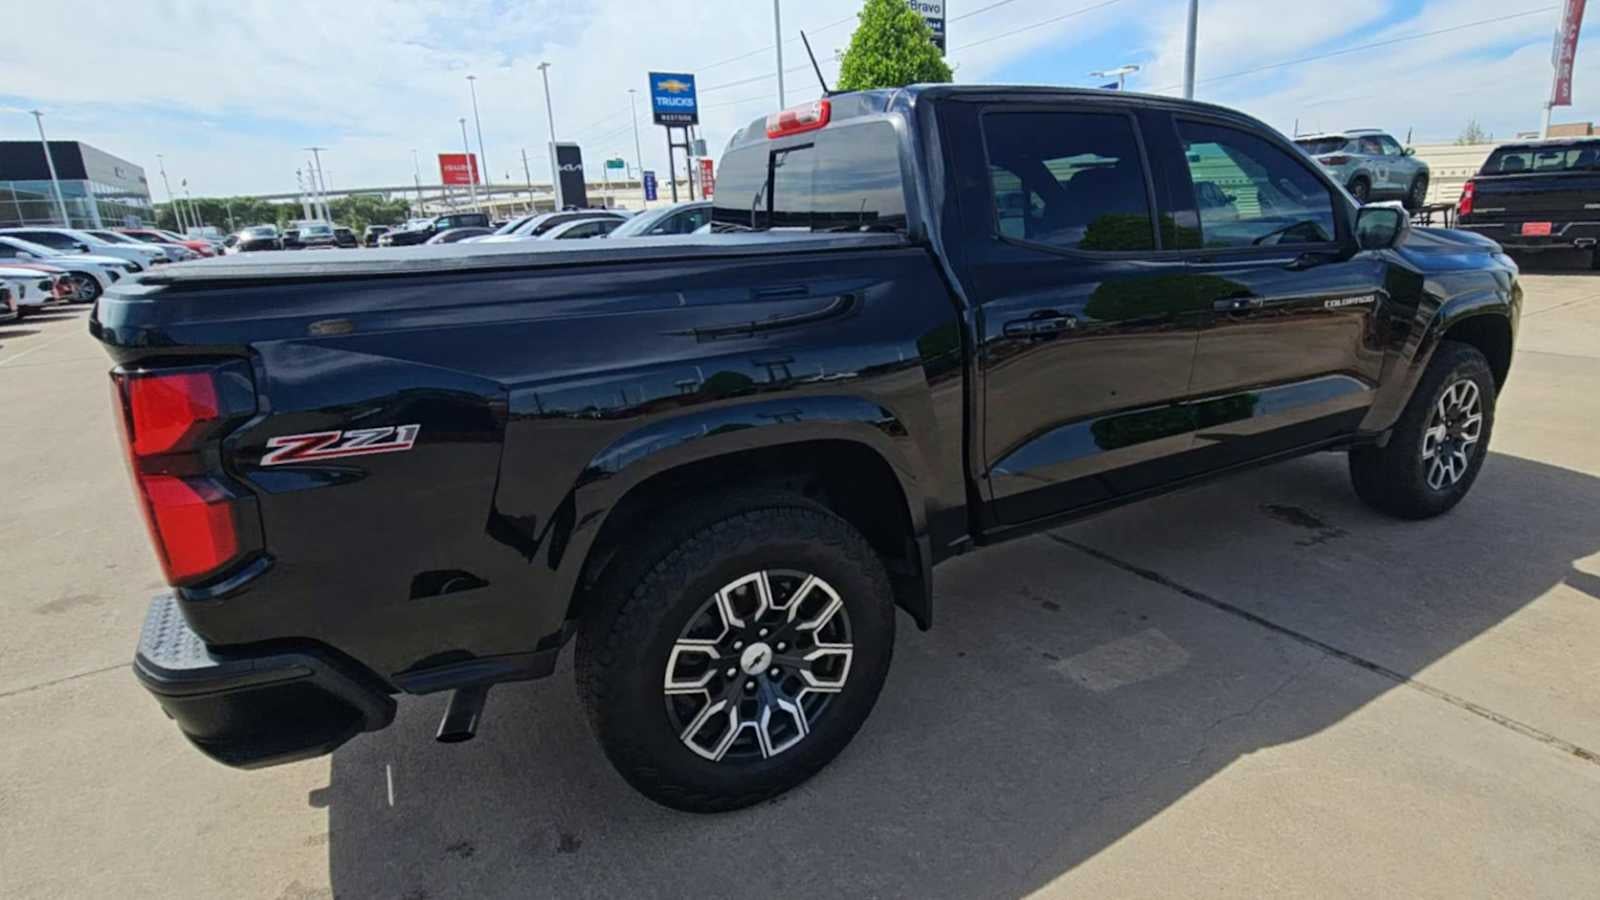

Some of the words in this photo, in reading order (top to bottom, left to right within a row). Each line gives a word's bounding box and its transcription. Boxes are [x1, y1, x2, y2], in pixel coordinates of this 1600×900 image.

[655, 96, 695, 107] TRUCKS
[1324, 294, 1376, 308] COLORADO
[259, 424, 421, 466] Z71
